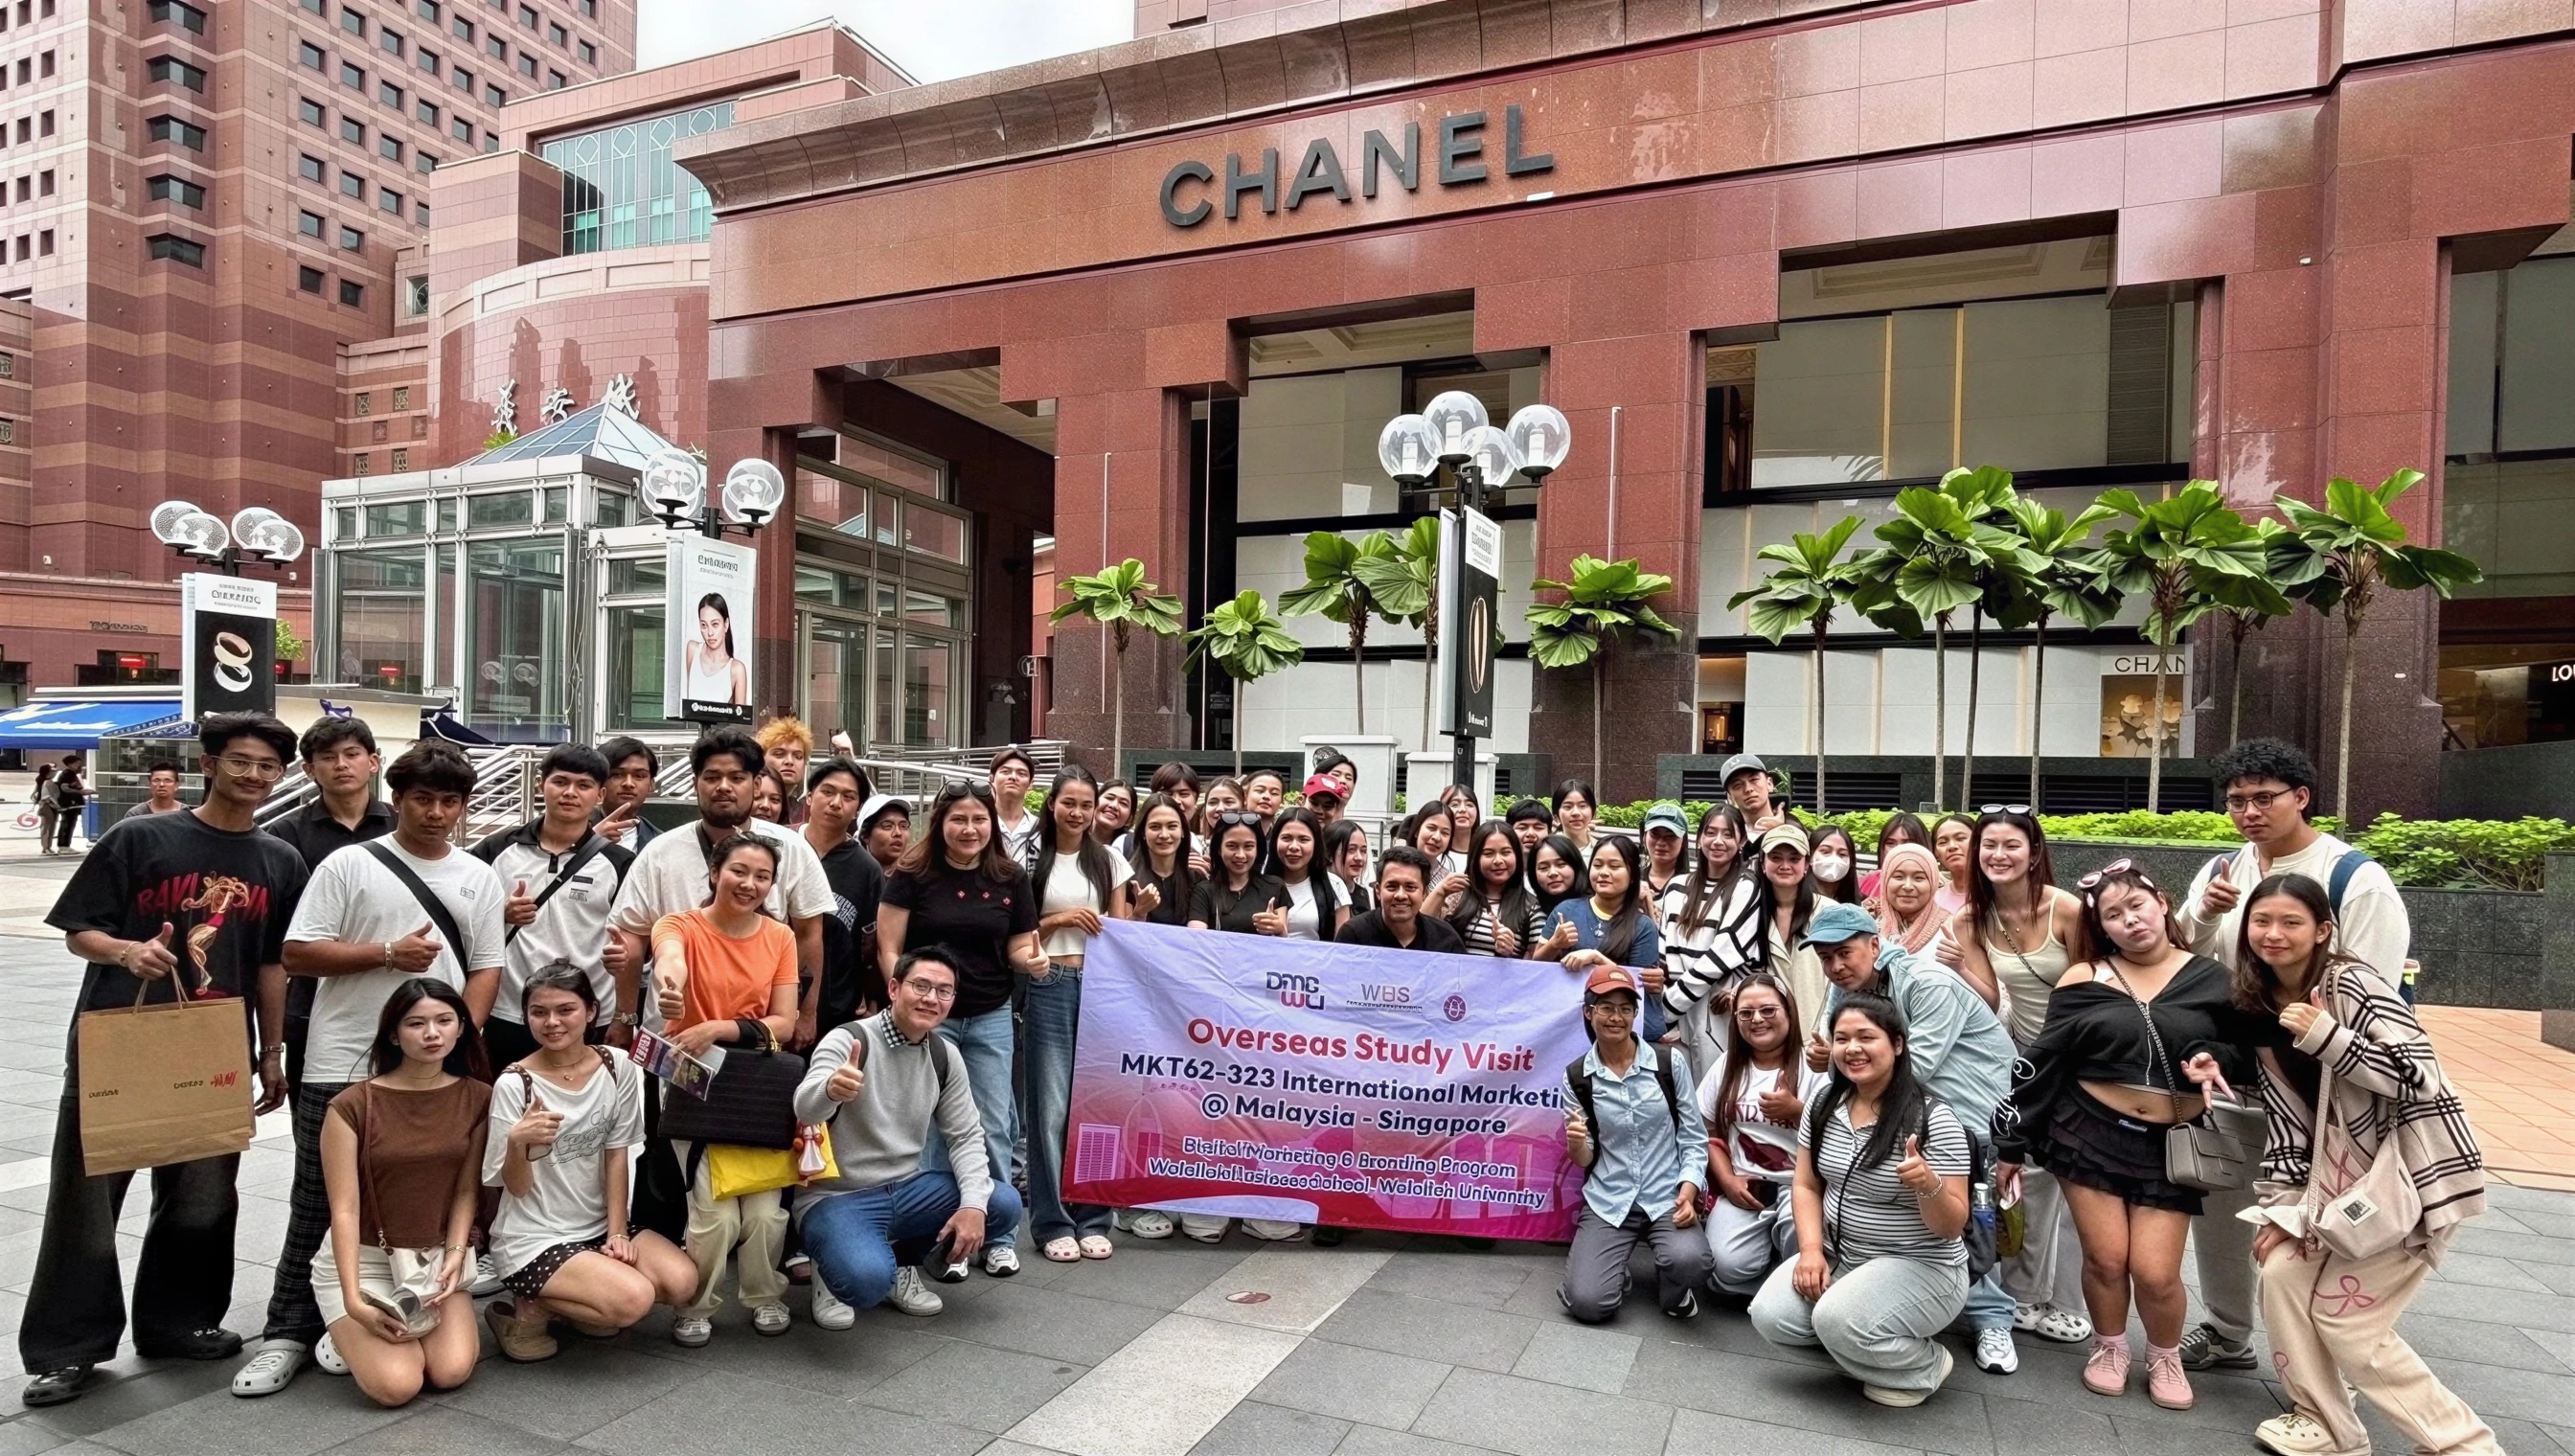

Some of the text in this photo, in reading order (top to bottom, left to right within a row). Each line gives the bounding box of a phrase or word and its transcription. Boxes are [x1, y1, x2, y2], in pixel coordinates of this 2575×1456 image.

[1159, 103, 1554, 227] CHANEL
[1187, 1018, 1535, 1075] Overseas Study Visit
[1120, 1053, 1275, 1088] MKT62-323
[1283, 1069, 1455, 1103] International
[1201, 1093, 1229, 1119] @
[1235, 1095, 1356, 1128] Malaysia
[1378, 1109, 1507, 1137] Singapore
